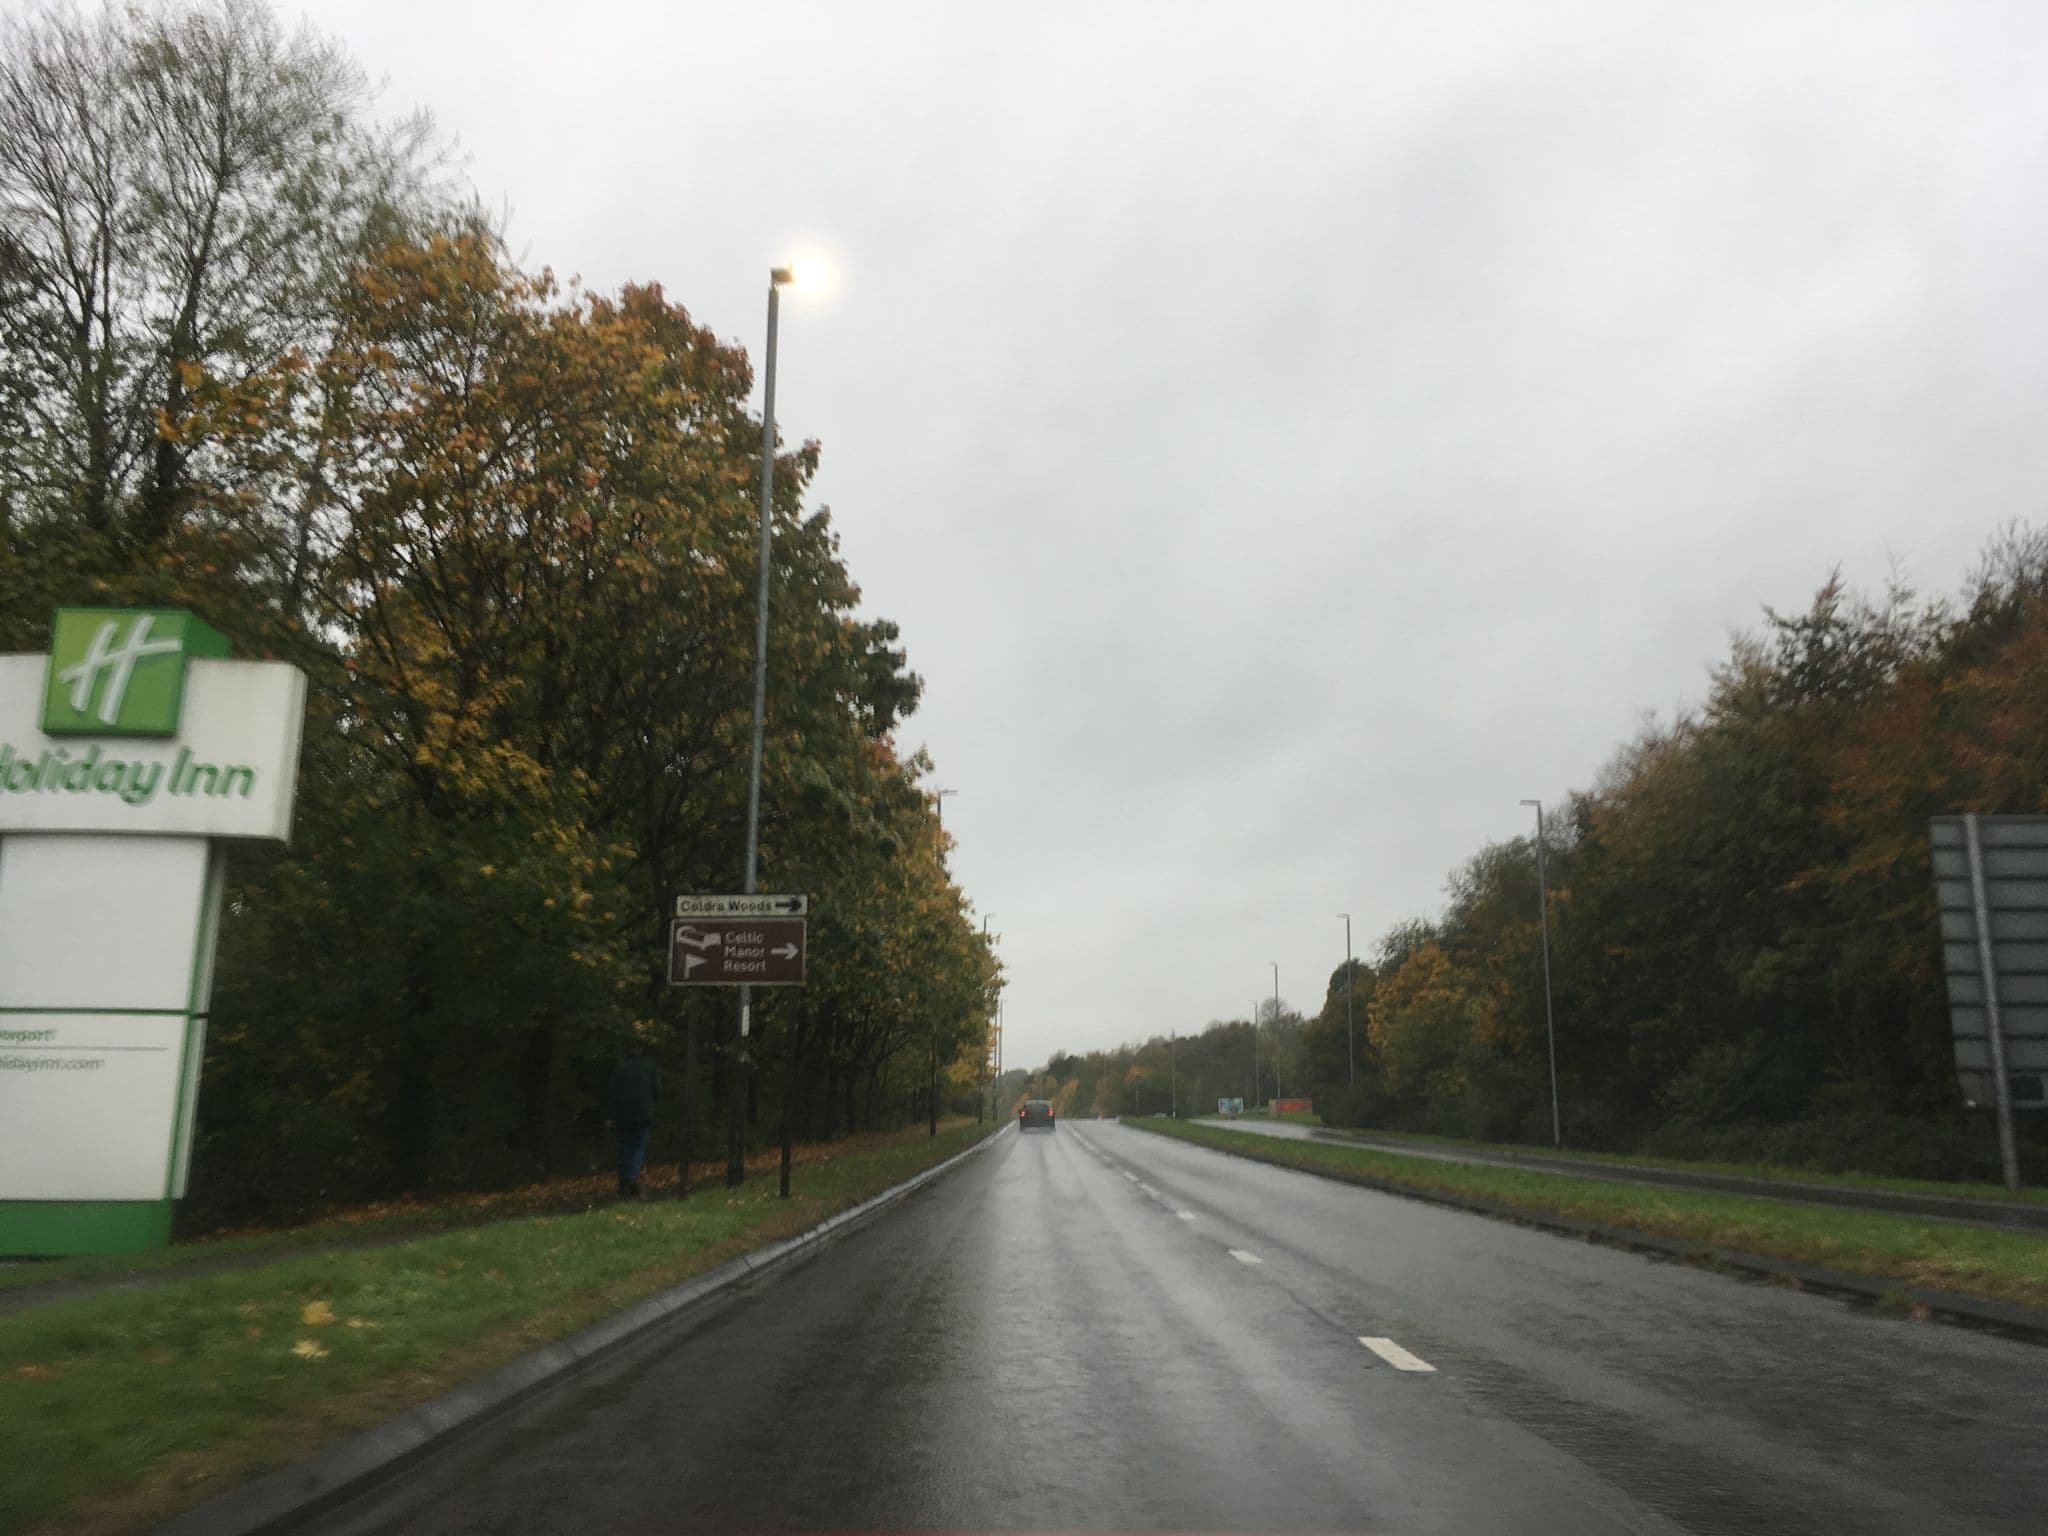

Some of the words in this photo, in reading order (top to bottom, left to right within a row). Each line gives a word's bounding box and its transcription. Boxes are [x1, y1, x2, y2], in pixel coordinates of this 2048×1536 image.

[167, 745, 257, 799] Inn
[729, 899, 773, 912] Woods
[725, 930, 765, 944] Celtic
[724, 945, 767, 958] Manor
[723, 959, 768, 973] Resort
